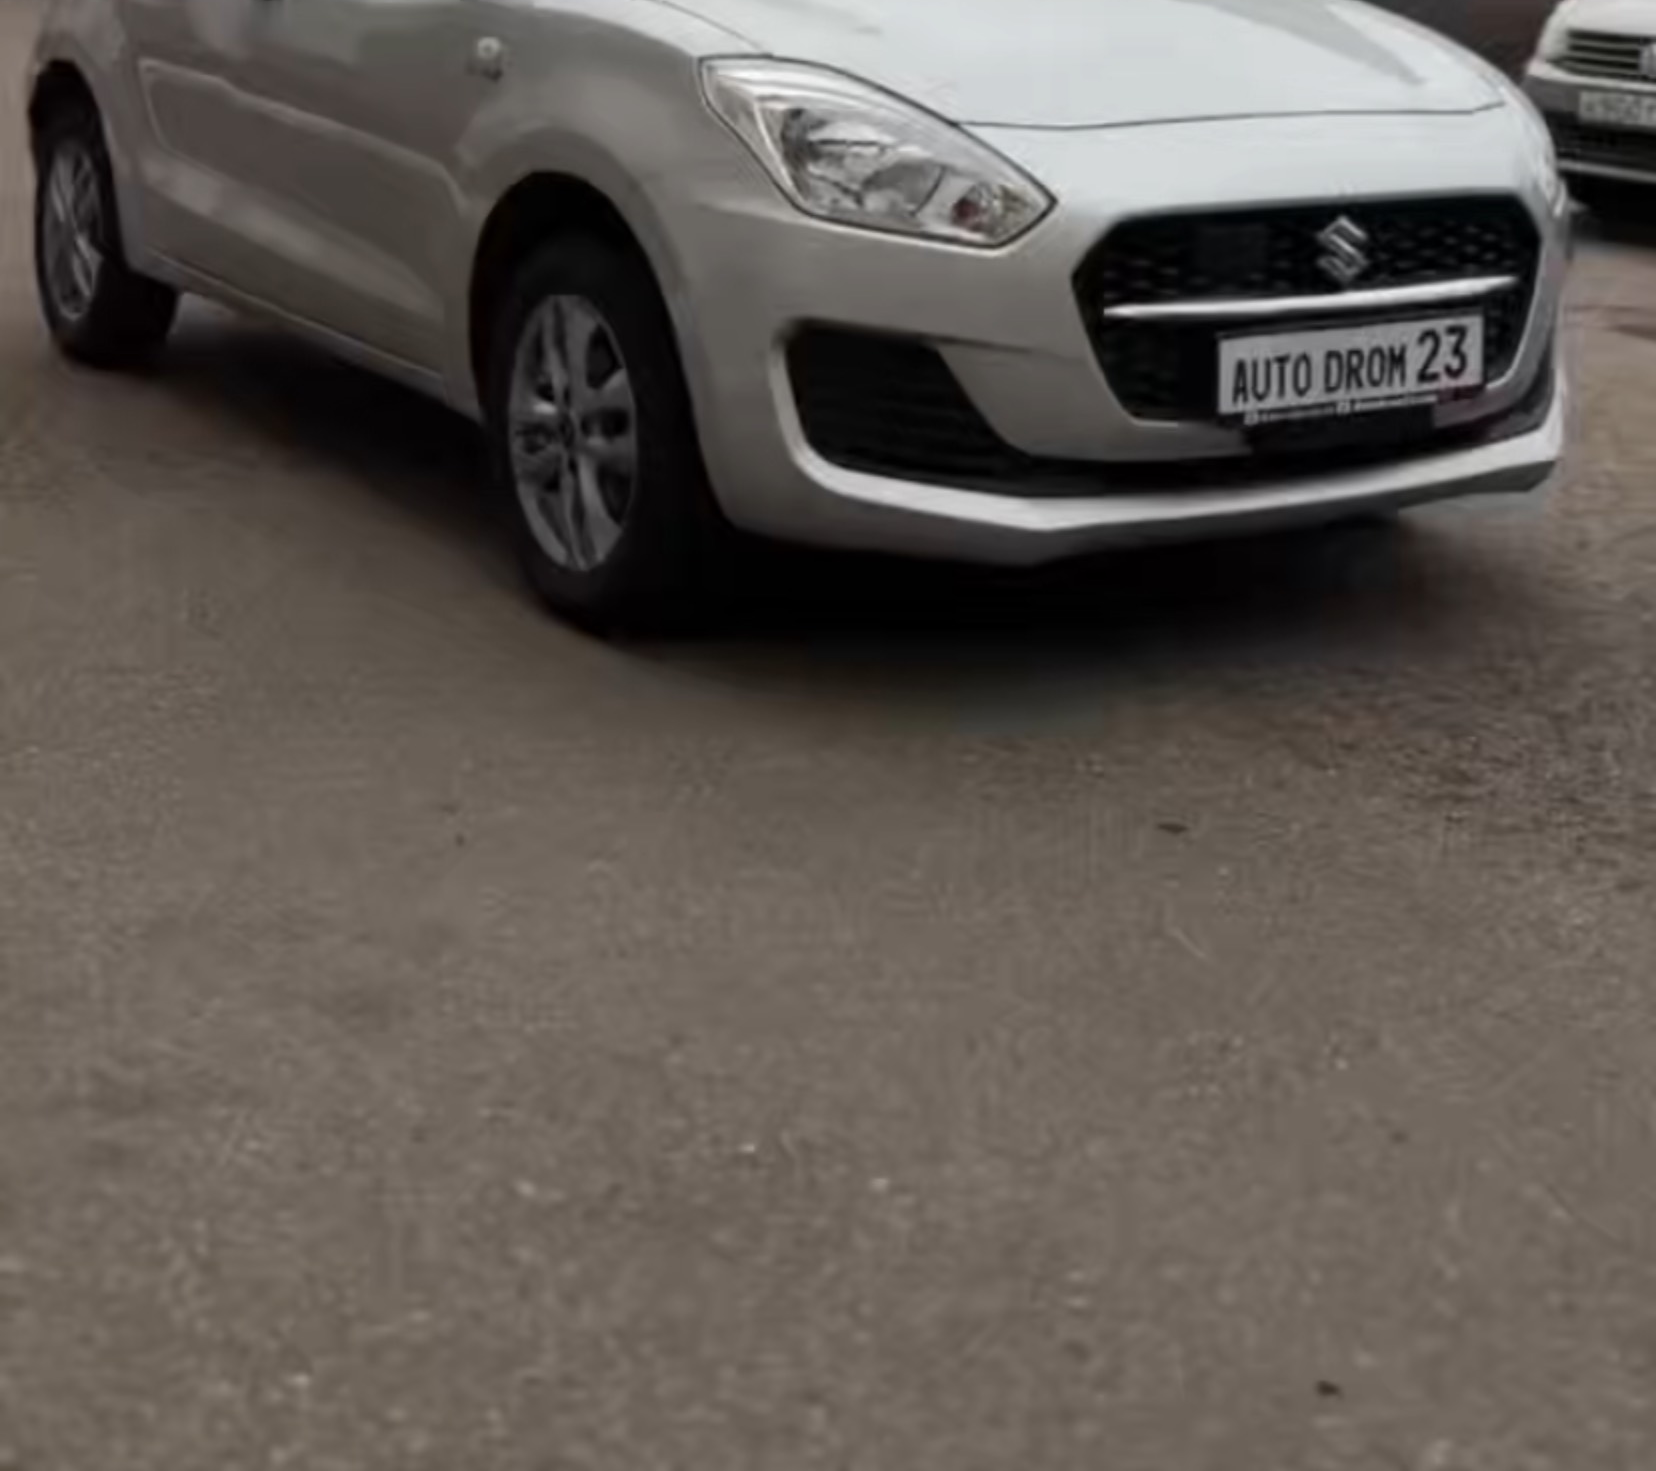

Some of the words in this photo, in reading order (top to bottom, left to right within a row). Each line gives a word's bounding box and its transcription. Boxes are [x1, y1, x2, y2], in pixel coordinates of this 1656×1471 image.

[1232, 351, 1312, 404] AUTO
[1324, 345, 1407, 394] DROM
[1416, 324, 1468, 383] 23
